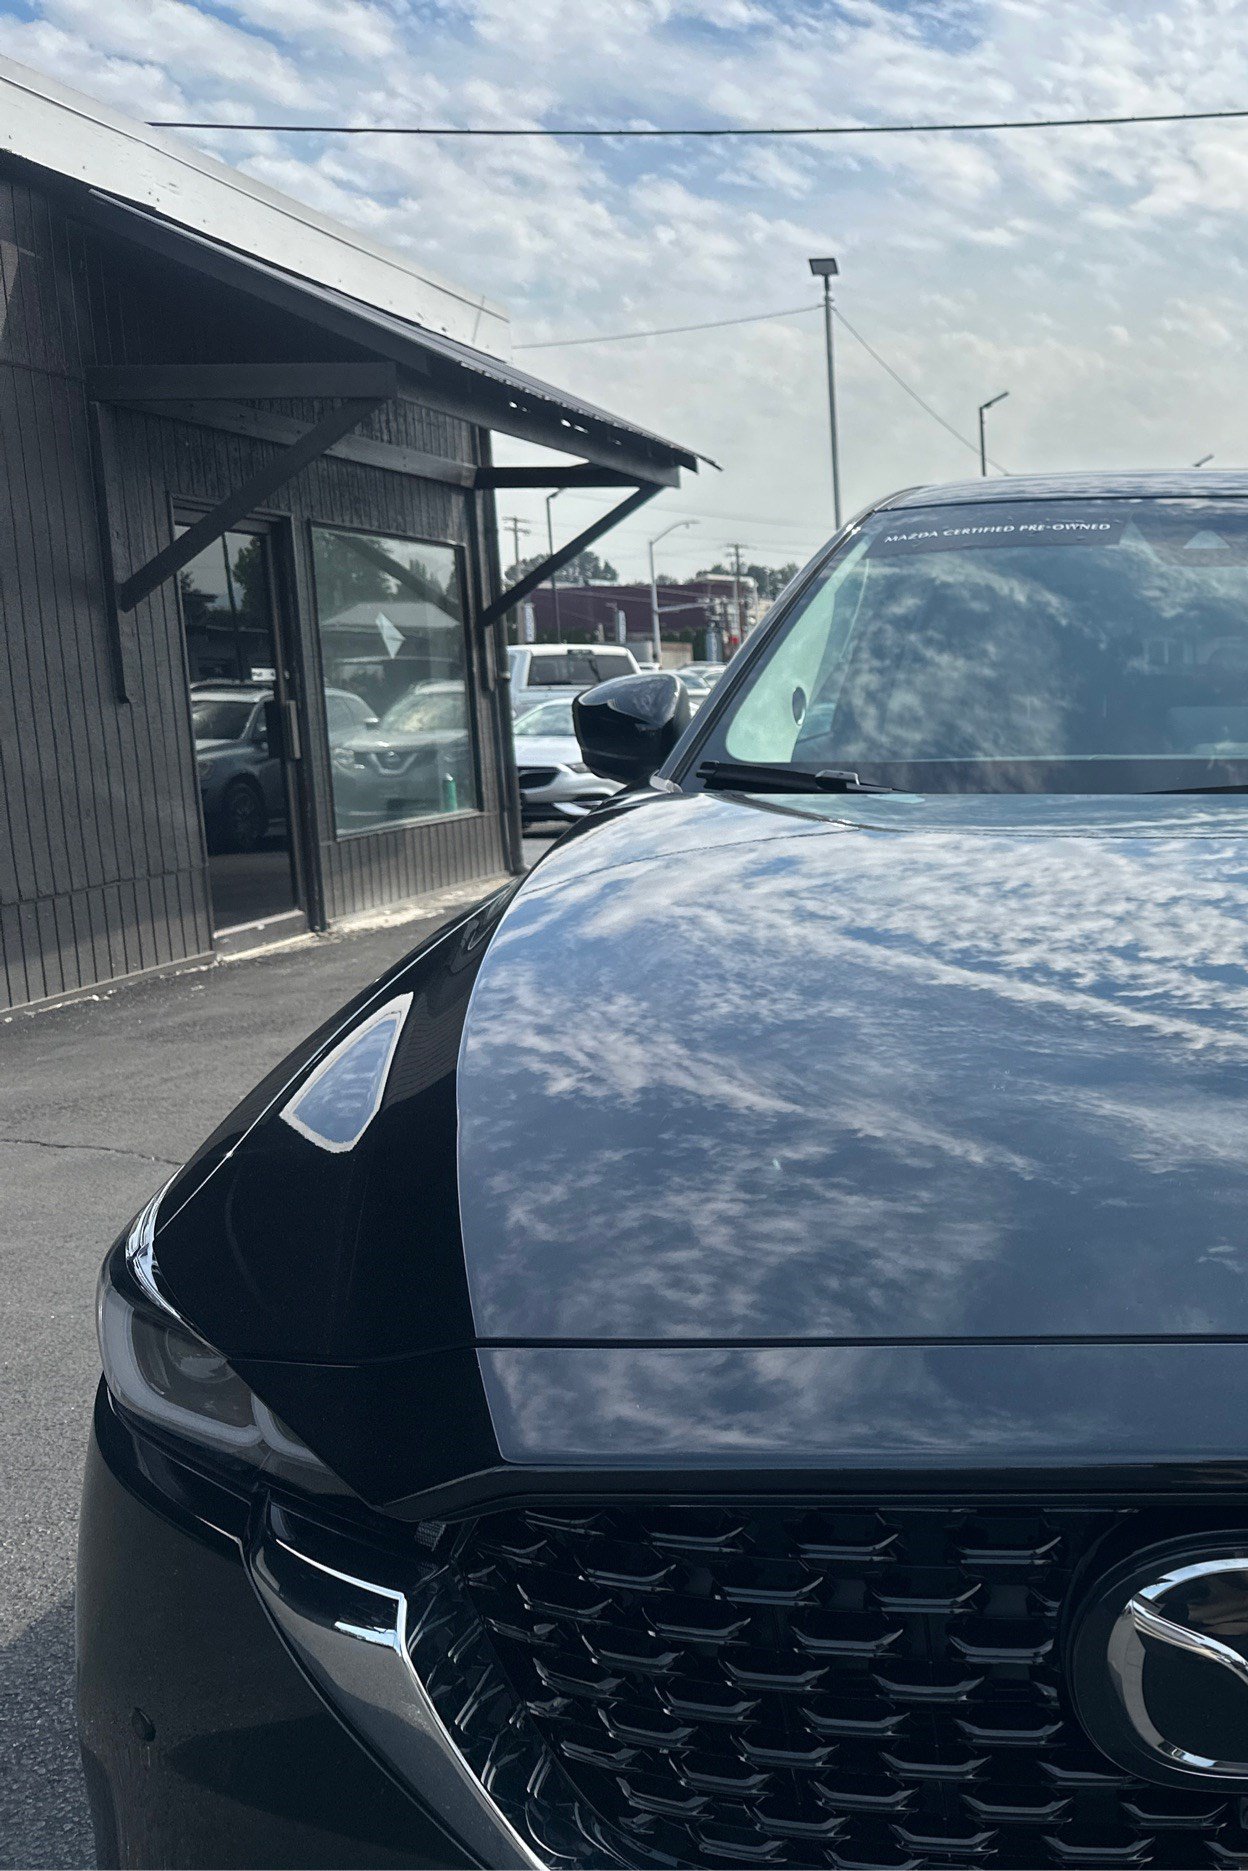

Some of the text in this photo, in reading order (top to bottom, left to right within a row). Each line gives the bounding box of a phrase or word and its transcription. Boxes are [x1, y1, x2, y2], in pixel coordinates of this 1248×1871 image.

[884, 523, 1111, 543] MAZDA CERTIFIED PRE-OWNED
